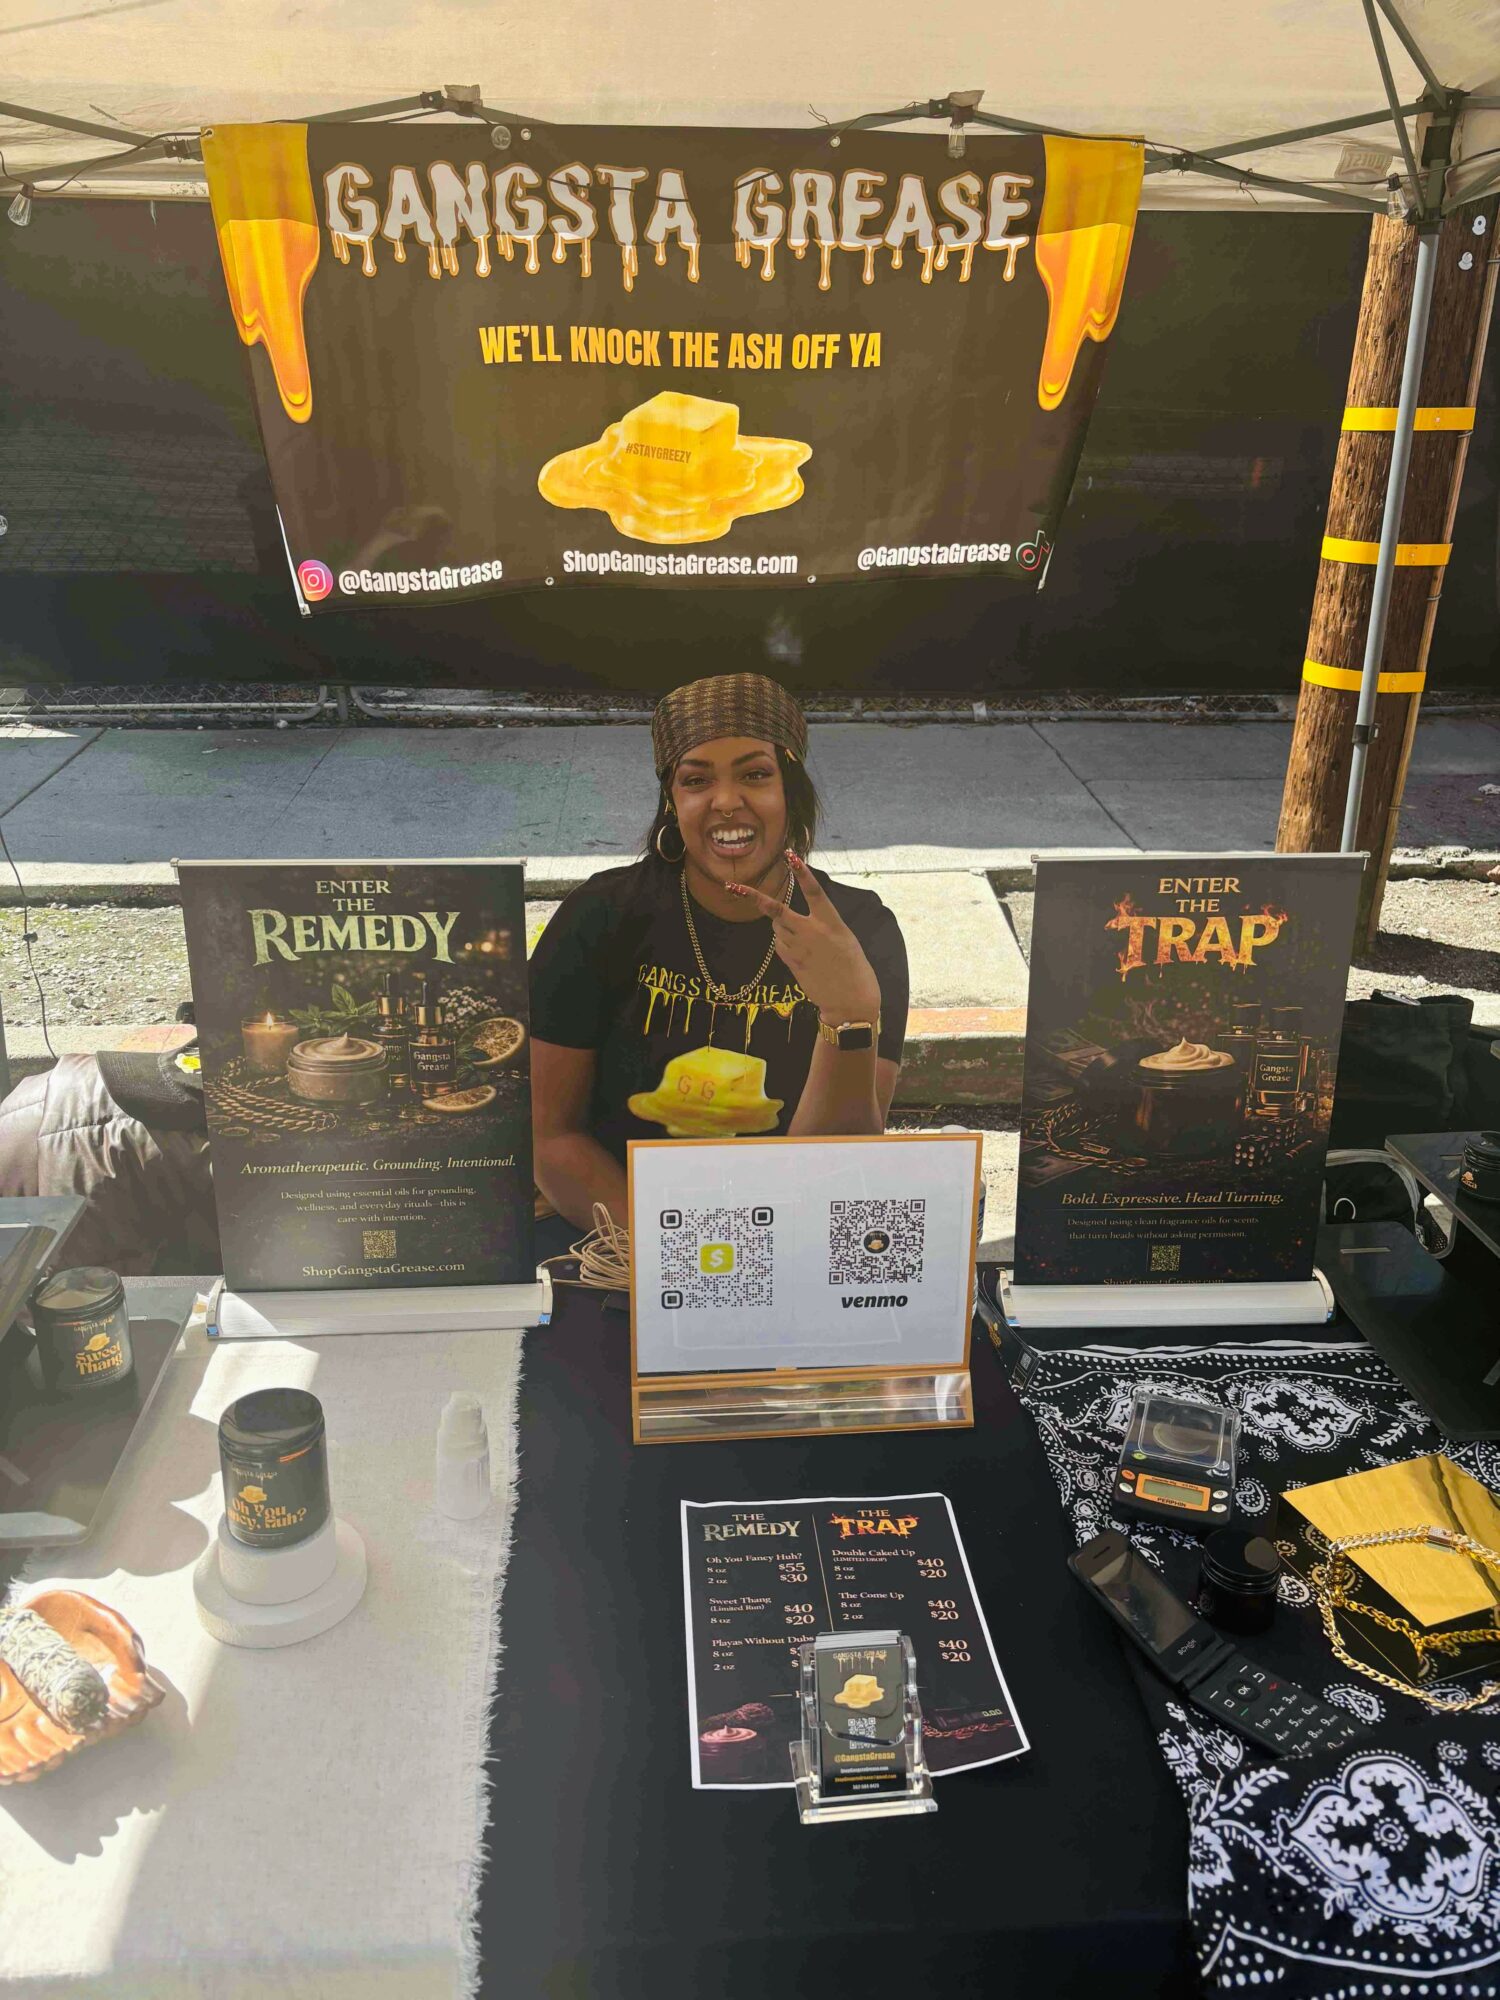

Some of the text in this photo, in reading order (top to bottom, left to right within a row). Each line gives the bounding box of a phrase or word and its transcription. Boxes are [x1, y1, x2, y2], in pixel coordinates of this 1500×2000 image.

[322, 160, 1033, 288] GANGSTA GREASE
[479, 325, 882, 370] WE'LL KNOCK THE ASH OFF YA
[625, 442, 692, 464] #STAYGREEZY
[857, 543, 1011, 570] @GangstaGrease
[563, 550, 798, 577] ShopGangstaGrease.com
[339, 560, 503, 594] @GangstaGrease
[316, 880, 391, 895] ENTER
[1158, 877, 1241, 894] ENTER
[332, 898, 375, 912] THE
[1175, 898, 1220, 913] THE
[247, 909, 461, 966] REMEDY
[1107, 908, 1286, 976] TRAP
[1259, 1063, 1294, 1075] Gangsta
[1262, 1073, 1291, 1083] Grease
[240, 1155, 516, 1175] Aromatherapeutic. Grounding. Intentional.
[281, 1190, 323, 1200] Designed
[326, 1190, 351, 1199] using
[353, 1188, 392, 1197] essential
[395, 1188, 411, 1196] oils
[412, 1187, 426, 1195] for
[1062, 1191, 1284, 1207] Bold. Expressive. Head Turning.
[340, 1202, 357, 1210] and
[359, 1201, 401, 1211] everyday
[360, 1214, 381, 1222] with
[1067, 1218, 1107, 1227] Designed
[302, 1263, 465, 1278] ShopGangstaGrease.com
[841, 1293, 908, 1309] venmo
[75, 1341, 121, 1362] Sweet
[76, 1352, 123, 1376] Thang
[732, 1513, 765, 1521] THE
[857, 1509, 891, 1517] THE
[702, 1521, 800, 1541] REMEDY
[830, 1515, 919, 1538] TRAP
[831, 1548, 916, 1557] Double Caked Up
[706, 1556, 722, 1564] Oh
[745, 1555, 774, 1563] Fancy
[917, 1558, 944, 1568] $40
[778, 1562, 806, 1573] $55
[919, 1569, 947, 1578] $20
[780, 1573, 808, 1583] $30
[889, 1592, 905, 1600] Up
[784, 1603, 813, 1613] $40
[927, 1599, 956, 1609] $40
[785, 1615, 815, 1625] $20
[930, 1610, 959, 1620] $20
[712, 1635, 814, 1648] Playas Without Dubs
[938, 1640, 968, 1650] $40
[942, 1652, 971, 1662] $20
[1237, 1684, 1251, 1695] OK
